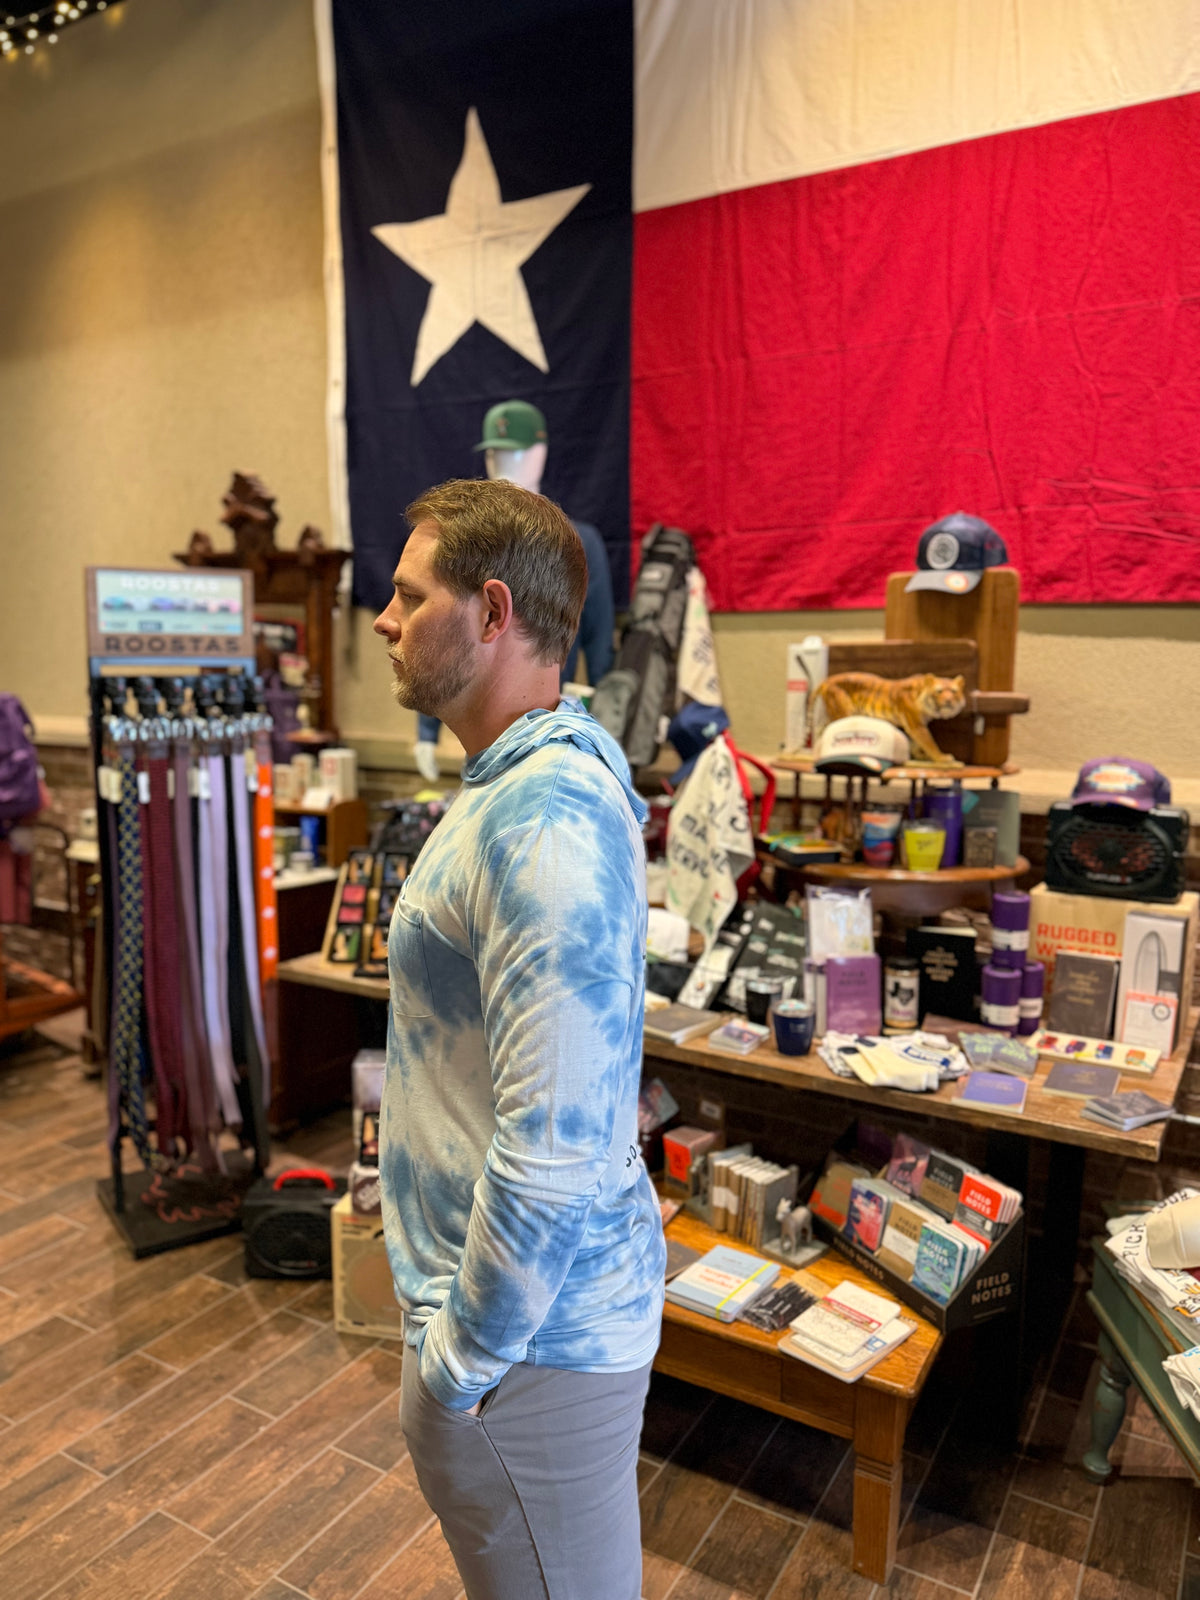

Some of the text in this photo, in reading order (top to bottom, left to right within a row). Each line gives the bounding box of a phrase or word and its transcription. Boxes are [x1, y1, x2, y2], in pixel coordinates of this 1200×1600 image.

[120, 575, 221, 592] ROOSTAS
[104, 636, 240, 653] ROOSTAS
[1036, 923, 1117, 947] RUGGED
[965, 1196, 992, 1215] NOTES
[969, 1189, 992, 1206] FIELD
[923, 1246, 950, 1267] NOTES
[926, 1239, 949, 1257] FIELD
[976, 1272, 1009, 1290] FIELD
[971, 1283, 1012, 1305] NOTES
